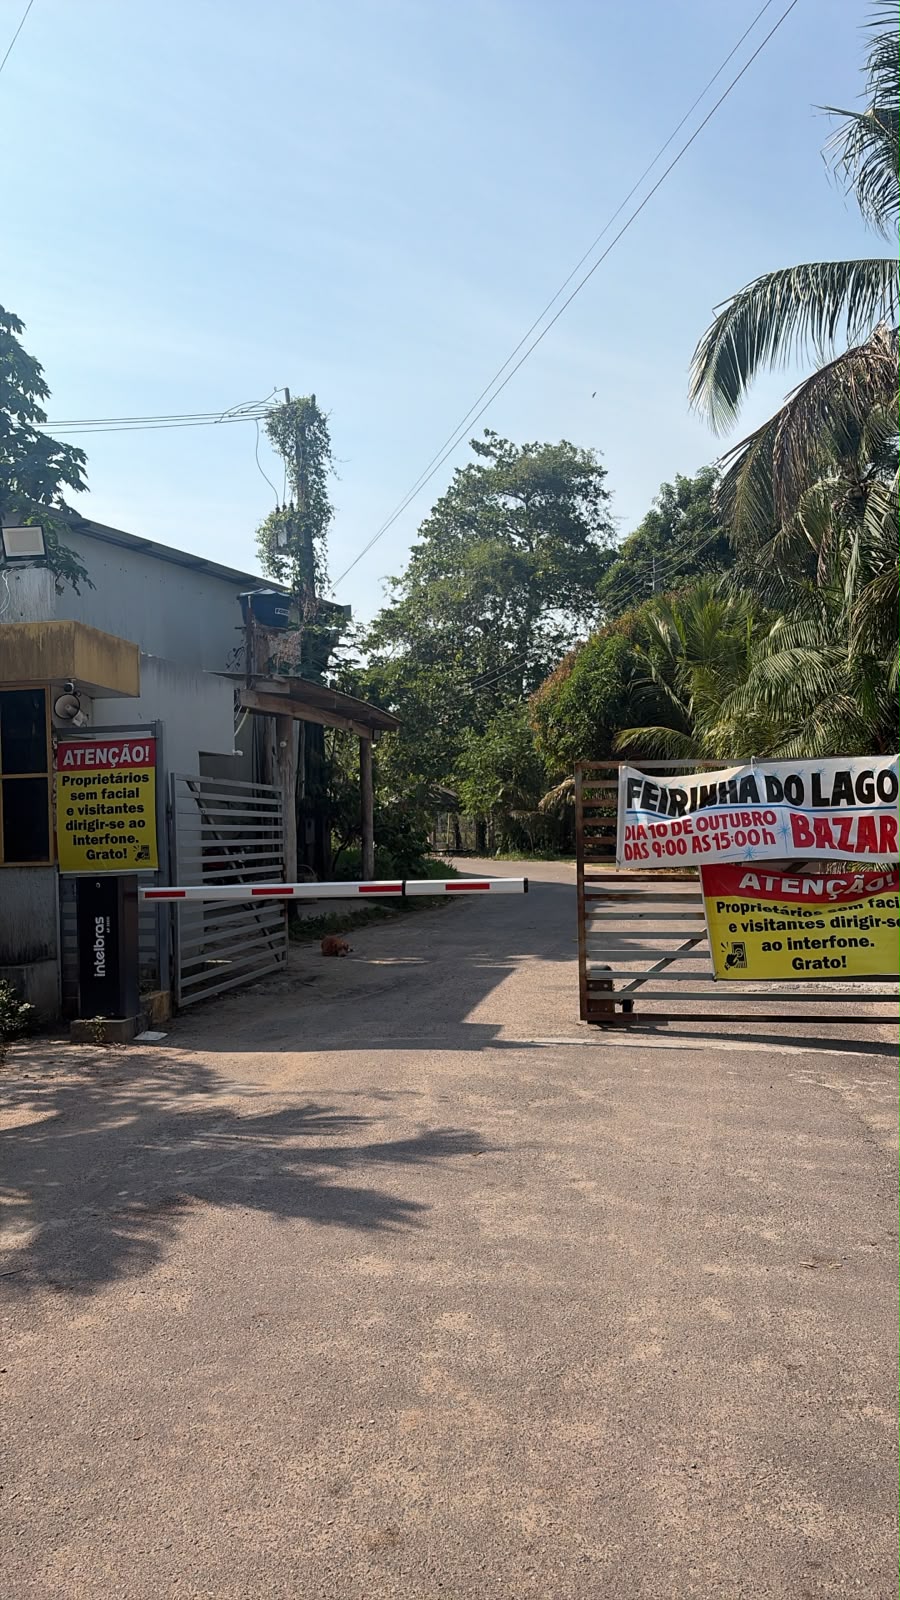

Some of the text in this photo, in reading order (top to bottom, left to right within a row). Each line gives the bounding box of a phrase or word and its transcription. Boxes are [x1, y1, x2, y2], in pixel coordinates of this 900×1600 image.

[62, 743, 150, 768] ATENÇÃO!
[61, 770, 149, 788] Proprietários
[70, 787, 140, 801] sem facial
[627, 768, 899, 817] FEIRINHA DO LAGO
[66, 803, 144, 816] e visitantes
[65, 818, 146, 833] dirigir-se ao
[624, 810, 777, 842] DIA 10 DE OUTUBRO
[789, 811, 898, 854] BAZAR
[72, 833, 139, 846] interfone.
[624, 841, 650, 861] DAS
[651, 839, 688, 858] 9:00
[691, 834, 712, 854] AS
[86, 847, 128, 860] Grato!
[738, 872, 895, 900] ATENÇÃO!
[867, 896, 900, 909] faci
[728, 922, 738, 933] e
[740, 916, 826, 933] visitantes
[93, 916, 106, 977] intelbras
[761, 935, 876, 952] ao interfone.
[791, 955, 848, 971] Grato!
